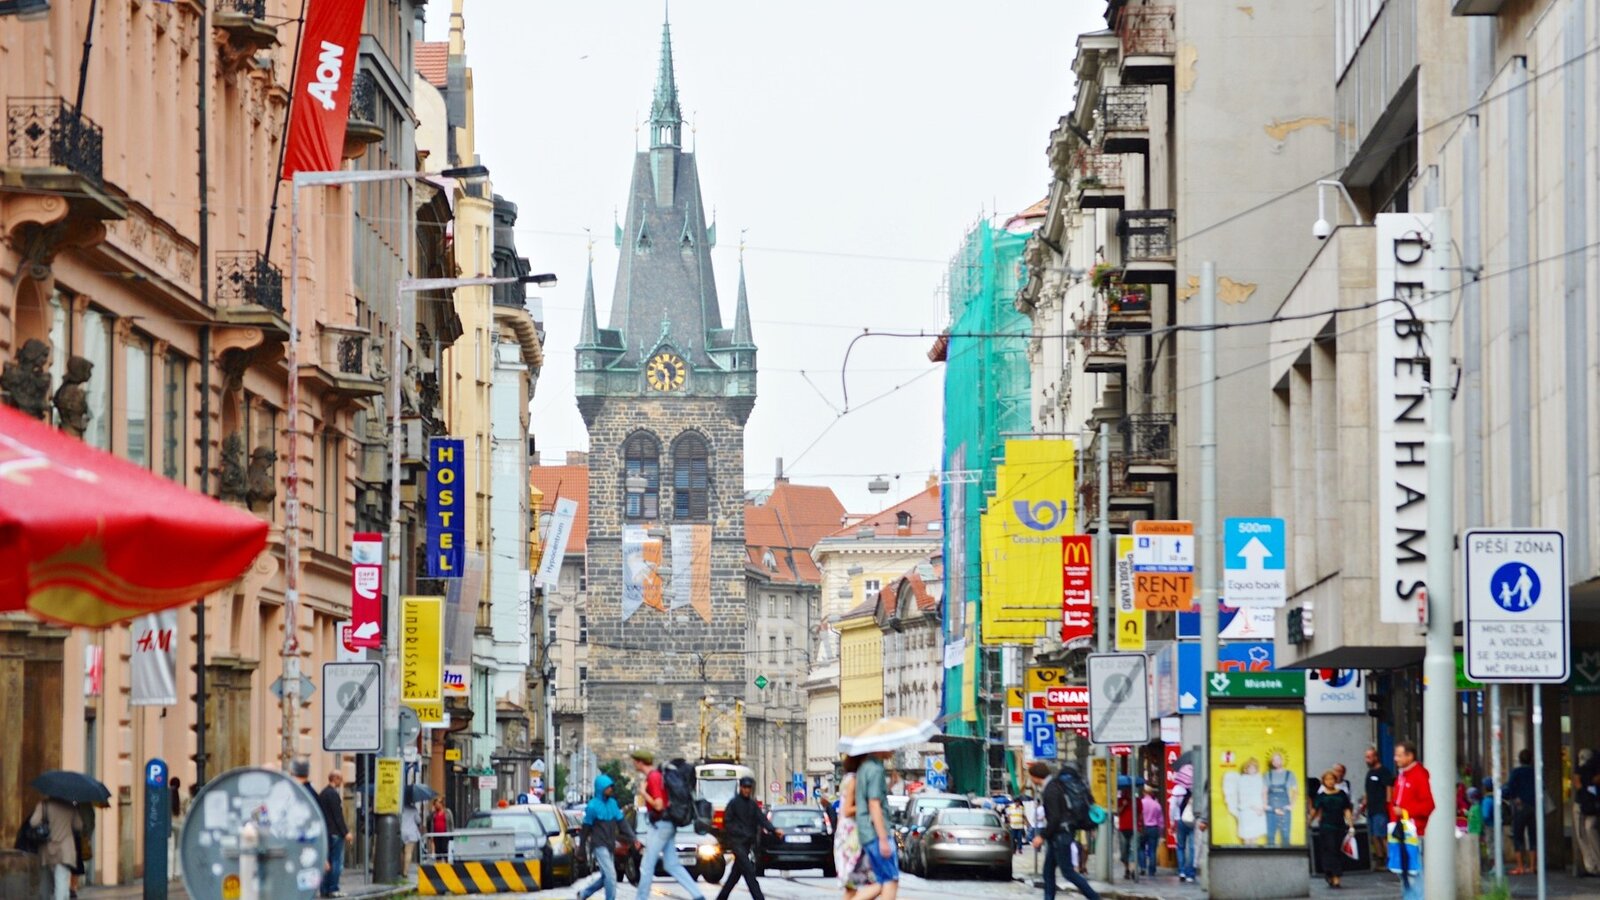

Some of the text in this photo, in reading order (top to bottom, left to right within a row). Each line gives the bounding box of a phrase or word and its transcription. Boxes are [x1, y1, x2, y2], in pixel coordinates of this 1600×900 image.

[1393, 238, 1426, 602] DEBENHAMS
[437, 446, 455, 571] HOSTEL
[1514, 537, 1554, 553] ZÓNA
[1137, 575, 1190, 593] RENT
[1256, 580, 1280, 589] bank
[1145, 594, 1179, 608] CAR
[136, 629, 172, 653] H&M
[1501, 639, 1544, 647] VOZIDLA
[1477, 651, 1557, 660] SE SOUHLASEM
[1505, 664, 1540, 673] PRAHA
[1048, 691, 1089, 703] CHAN
[418, 708, 440, 718] STEL
[1028, 714, 1042, 733] P
[1036, 727, 1050, 748] P
[151, 764, 162, 781] P
